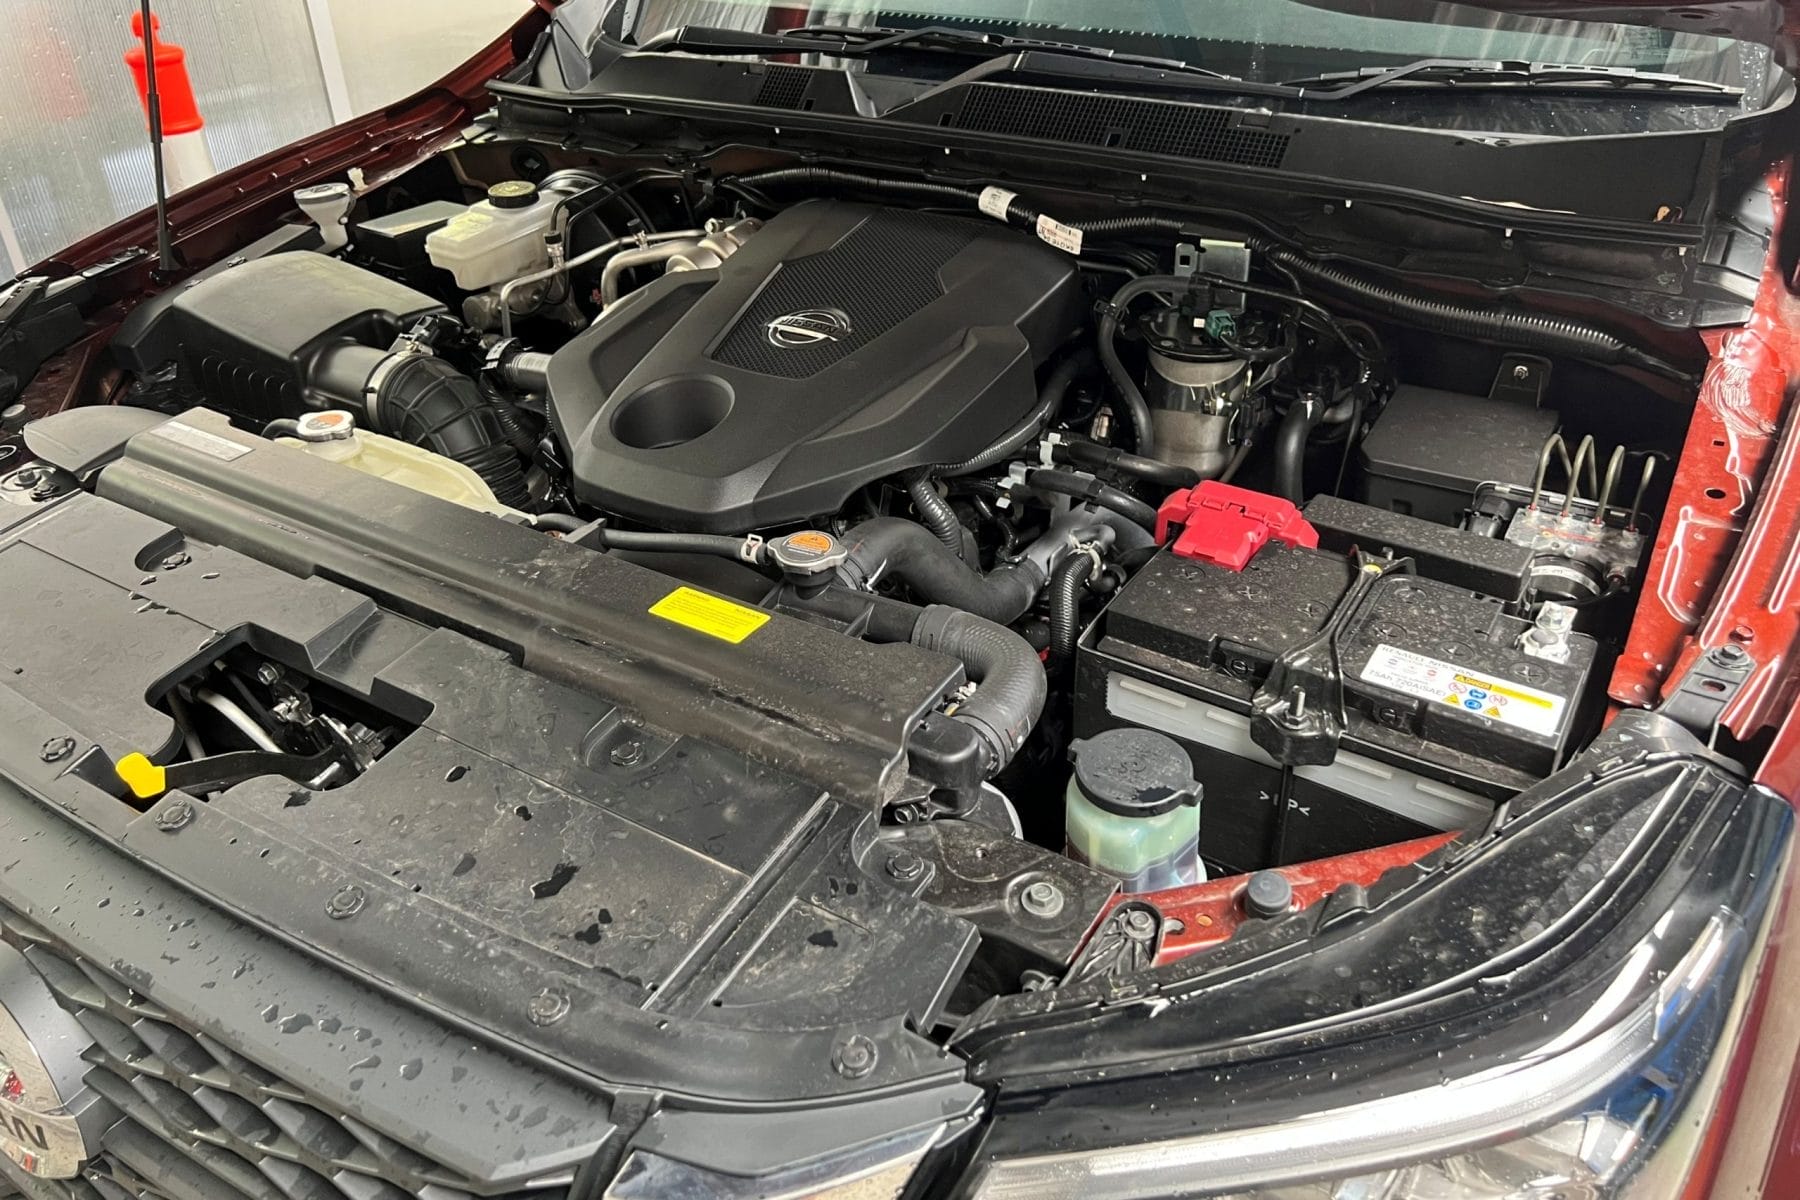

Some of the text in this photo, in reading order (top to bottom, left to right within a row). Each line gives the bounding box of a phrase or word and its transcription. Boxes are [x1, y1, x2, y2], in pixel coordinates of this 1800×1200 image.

[781, 317, 836, 335] NISSAN
[1382, 646, 1425, 662] RENAULT
[1428, 660, 1474, 677] NISSAN
